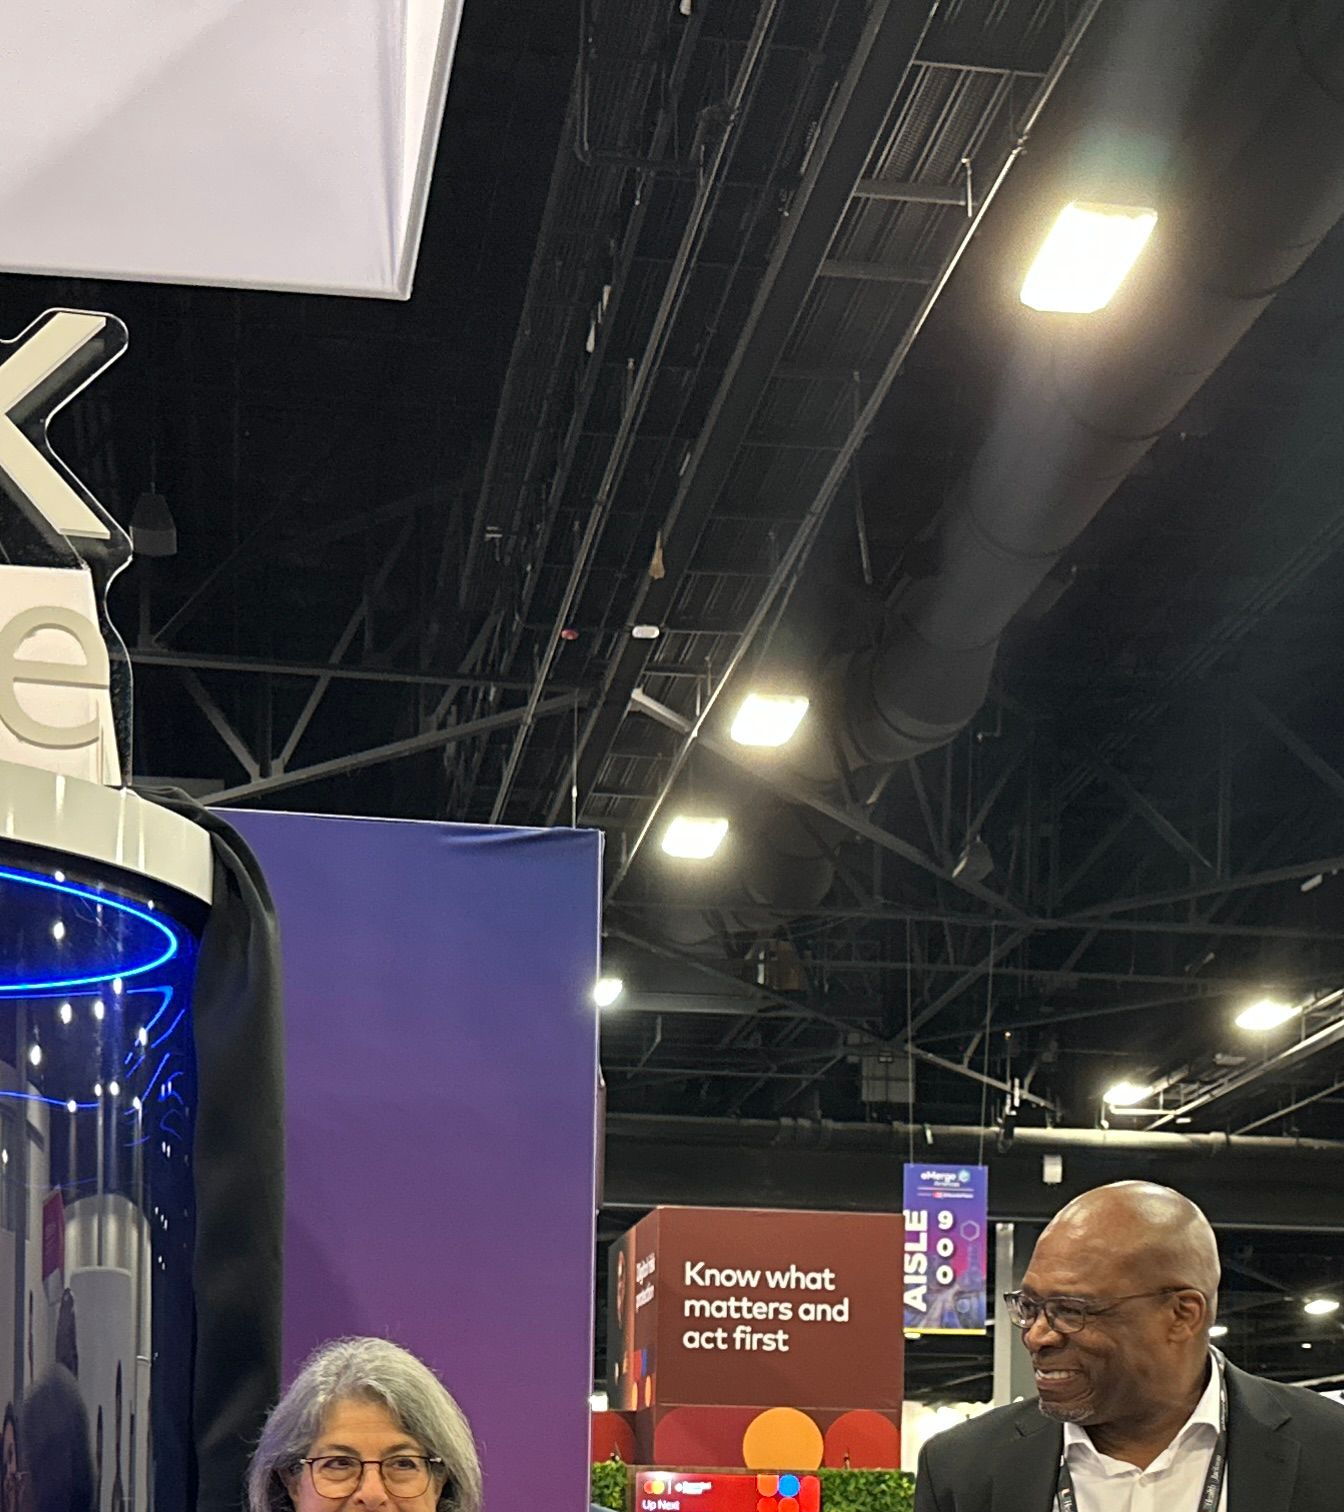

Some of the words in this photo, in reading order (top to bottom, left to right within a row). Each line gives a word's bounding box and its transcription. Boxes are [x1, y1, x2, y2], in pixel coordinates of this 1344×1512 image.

[903, 1209, 929, 1313] AISLE
[684, 1261, 762, 1288] Know
[765, 1264, 836, 1291] what
[683, 1296, 793, 1321] matters
[798, 1297, 850, 1322] and
[682, 1327, 728, 1350] act
[732, 1325, 790, 1352] first
